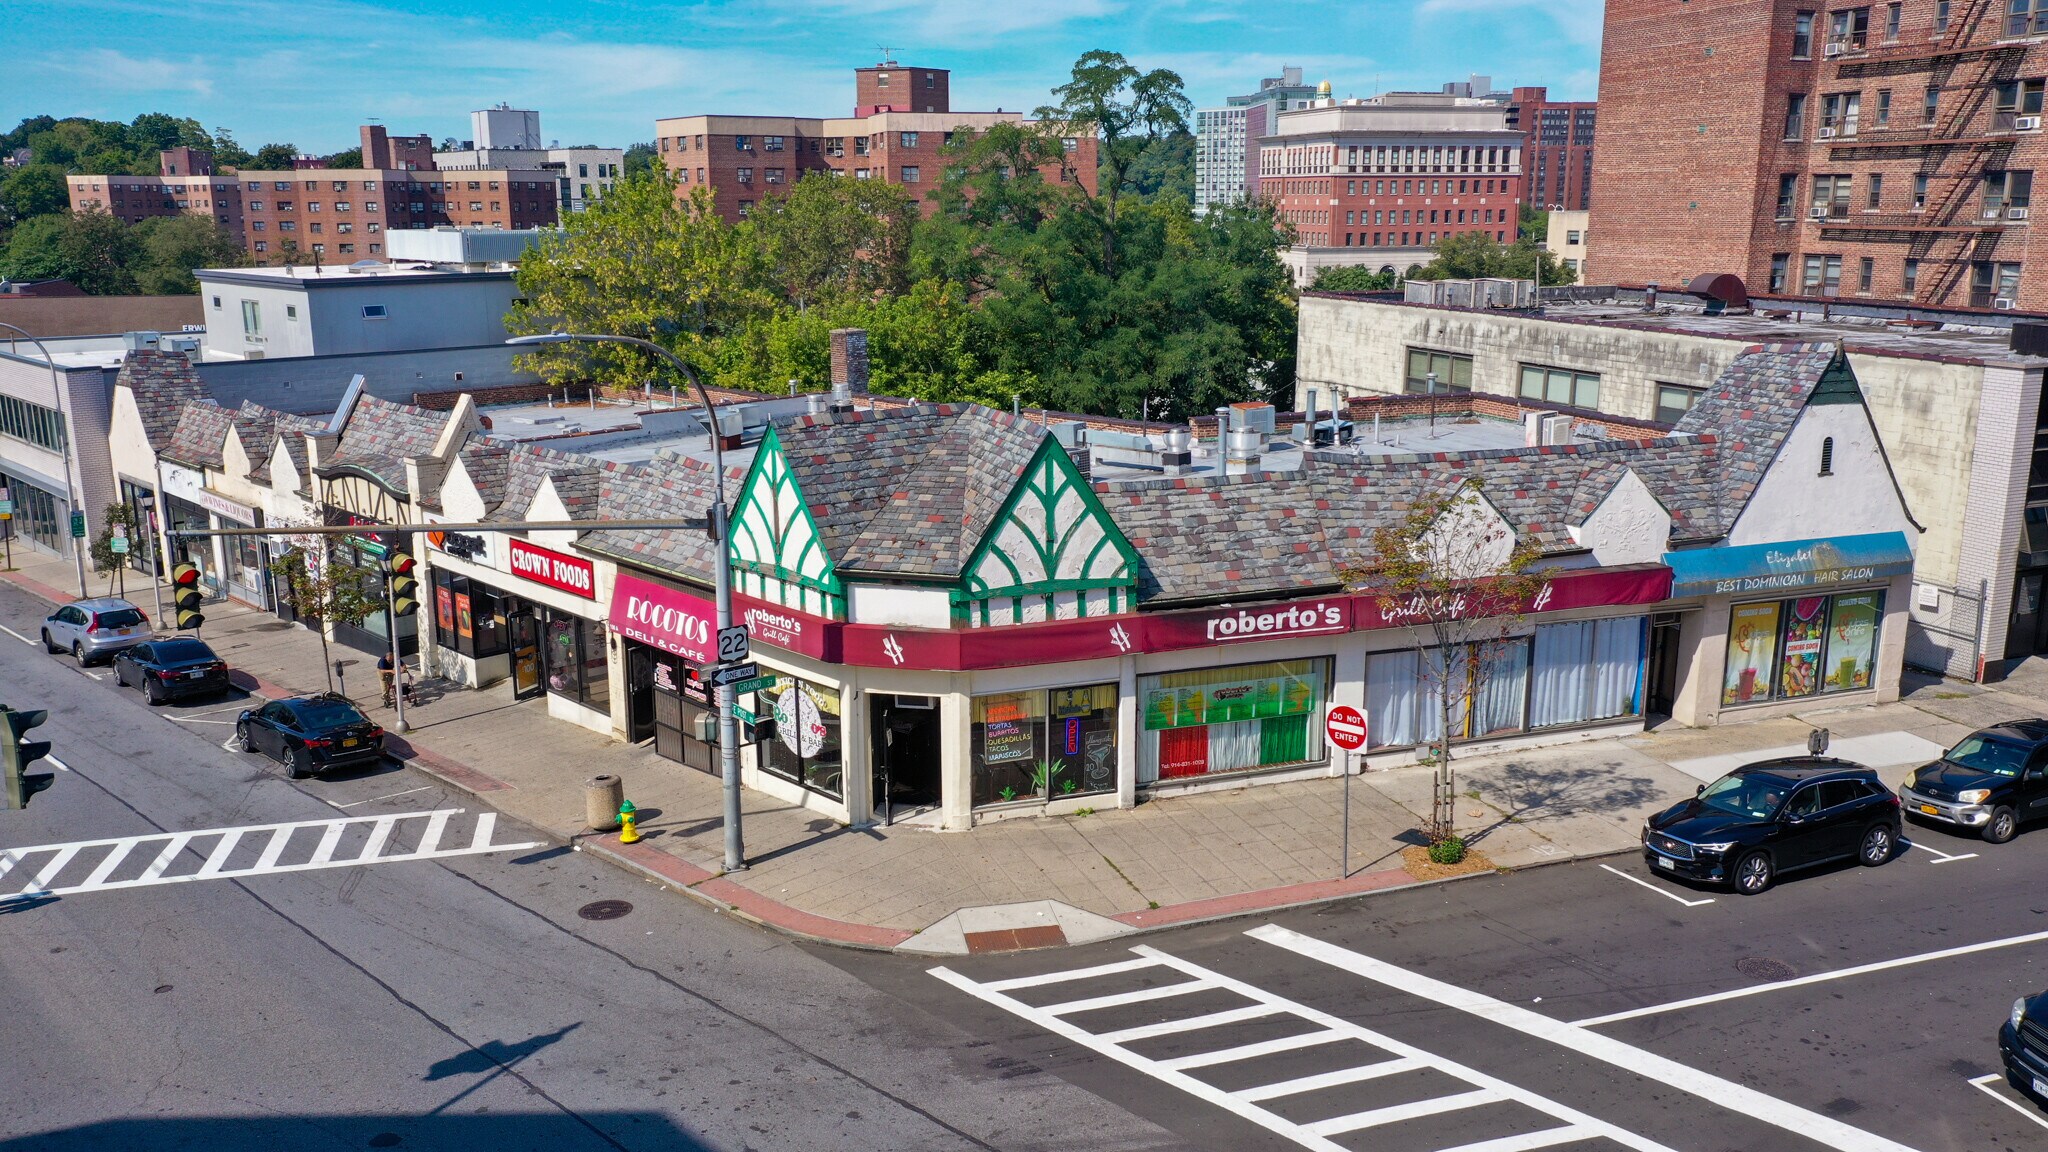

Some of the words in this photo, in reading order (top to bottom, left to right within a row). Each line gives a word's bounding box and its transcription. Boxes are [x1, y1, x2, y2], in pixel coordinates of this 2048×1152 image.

[512, 548, 550, 579] CROWN
[553, 559, 590, 590] FOODS
[1716, 579, 1741, 593] BEST
[1744, 574, 1805, 590] DOMINICAN
[1814, 570, 1839, 583] HAIR
[1841, 567, 1874, 580] SALON
[626, 596, 710, 644] ROCOTOS
[752, 609, 801, 632] roberto's
[1207, 603, 1341, 640] roberto's
[762, 628, 777, 639] Grill
[625, 627, 655, 644] DELI
[657, 639, 667, 649] &
[668, 643, 705, 663] CAFÉ
[721, 632, 746, 656] 22
[725, 671, 738, 680] ONE
[740, 667, 753, 677] WAY
[738, 680, 762, 692] GRAND
[733, 705, 737, 715] E
[737, 708, 747, 719] POST
[1332, 712, 1343, 721] DO
[1346, 715, 1362, 724] NOT
[778, 726, 797, 738] GRILL
[988, 722, 1012, 730] TORTAS
[988, 728, 1020, 738] BURRITOS
[1068, 719, 1077, 752] OPEN
[1334, 732, 1358, 744] ENTER
[988, 734, 1031, 746] QUESADILLAS
[989, 744, 1010, 752] TACOS
[988, 750, 1022, 761] MARISCOS
